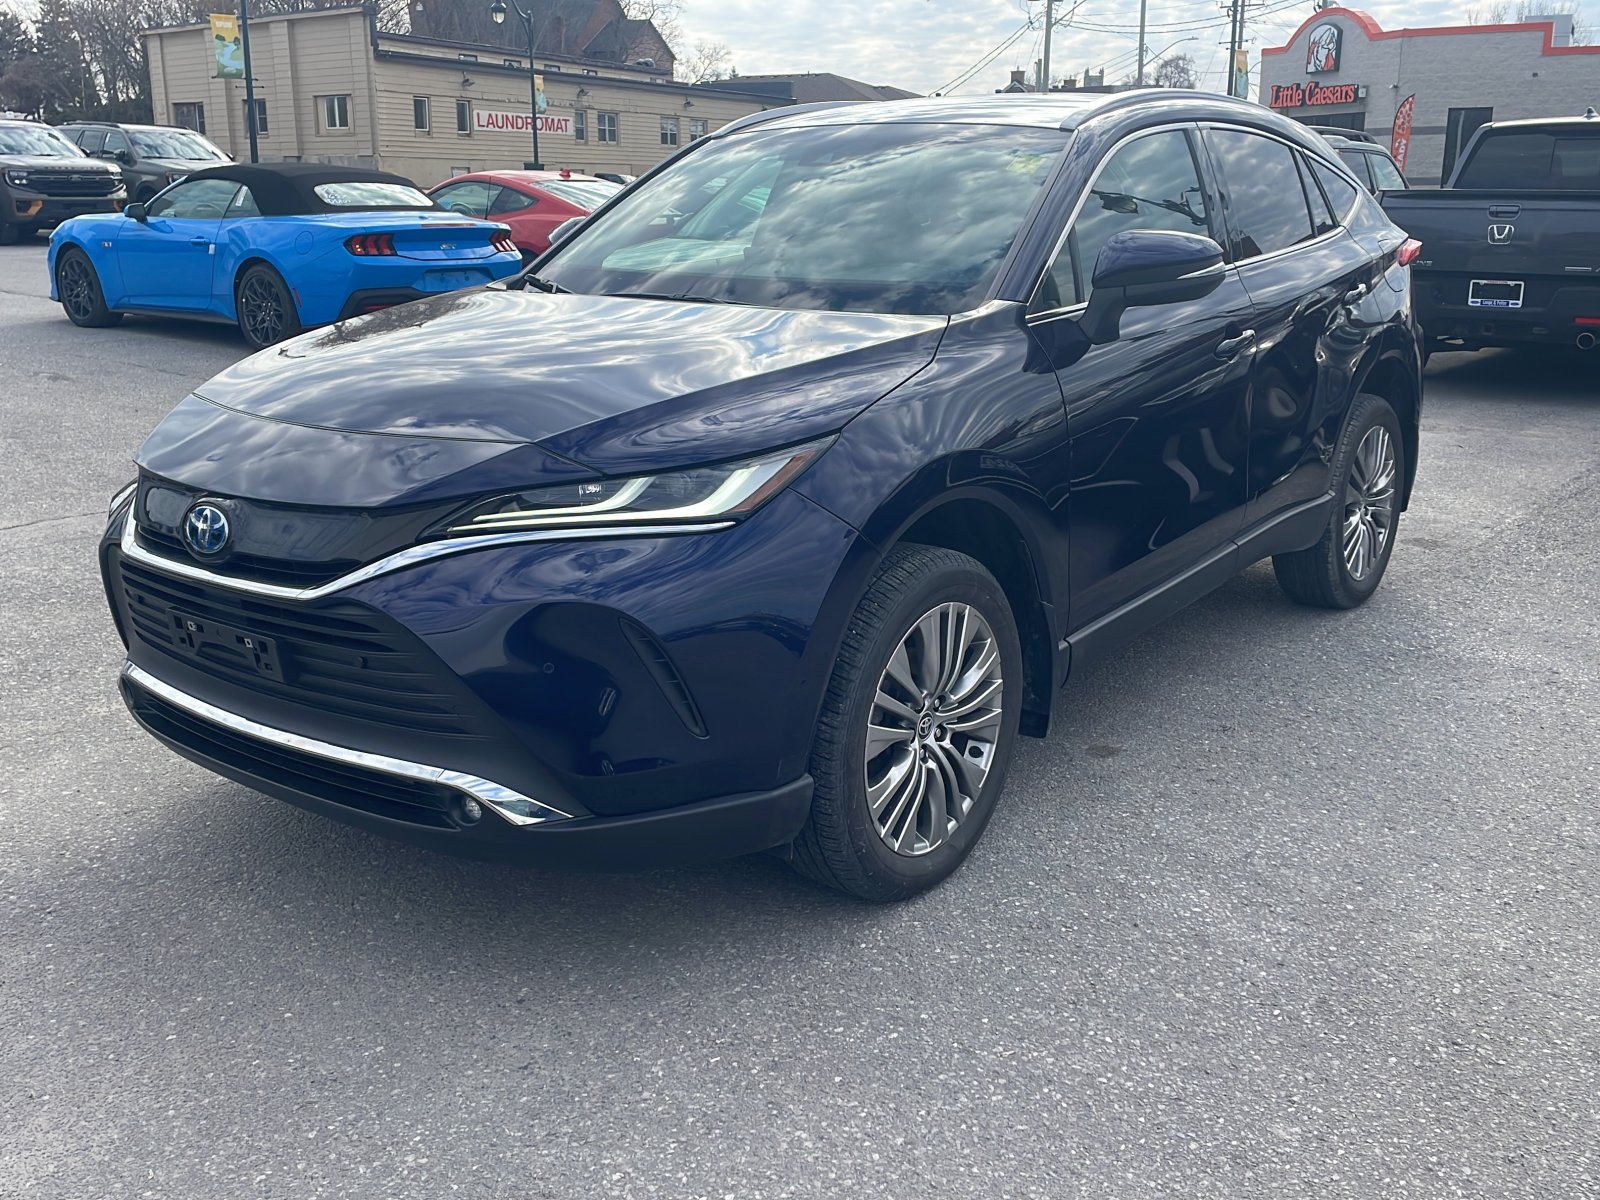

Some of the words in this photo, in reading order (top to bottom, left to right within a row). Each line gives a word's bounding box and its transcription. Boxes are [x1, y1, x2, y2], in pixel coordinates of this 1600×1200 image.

[1270, 83, 1302, 108] Little
[1305, 81, 1355, 106] Caesars
[477, 112, 570, 133] LAUNDROMAT
